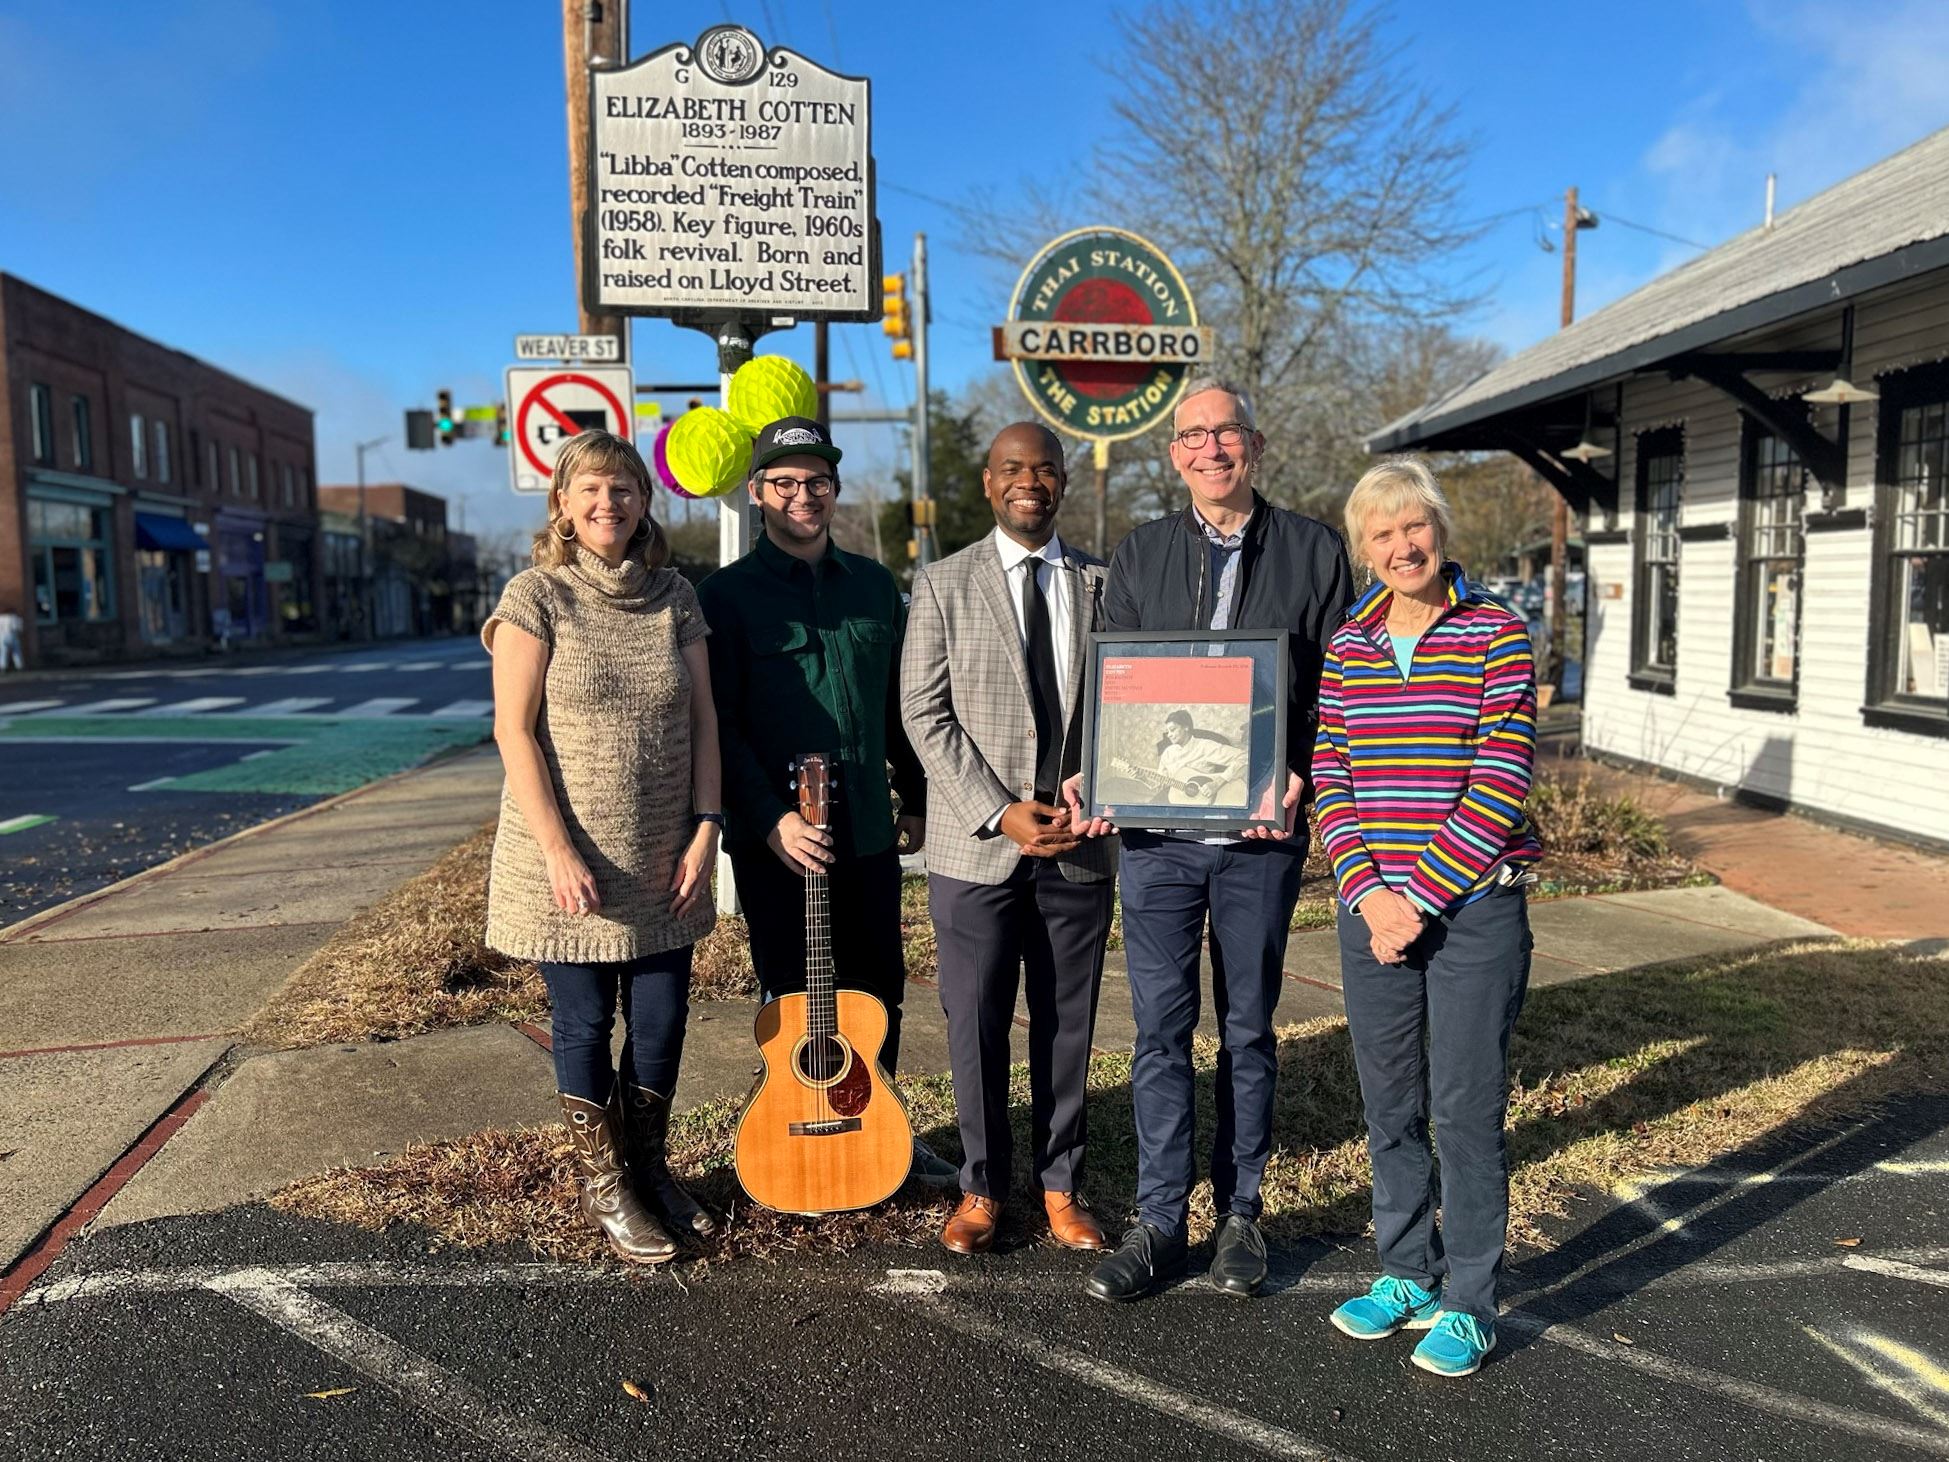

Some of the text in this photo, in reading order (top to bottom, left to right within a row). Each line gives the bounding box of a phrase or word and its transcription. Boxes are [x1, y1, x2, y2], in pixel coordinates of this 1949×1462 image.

[675, 69, 688, 83] G
[770, 72, 798, 87] 129
[607, 97, 855, 126] ELIZABETH COTTEN
[682, 156, 752, 178] Cotten
[755, 161, 862, 184] composed,
[602, 184, 704, 204] recorded
[602, 210, 863, 239] (1958). Key figure, 1960s
[603, 239, 863, 265] folk revival. Born and
[604, 269, 856, 295] raised on Lloyd Street.
[1032, 250, 1179, 318] THAI STATION
[520, 339, 615, 356] WEAVER ST
[1020, 329, 1199, 357] CARRBORO
[1039, 367, 1173, 425] THE STATION
